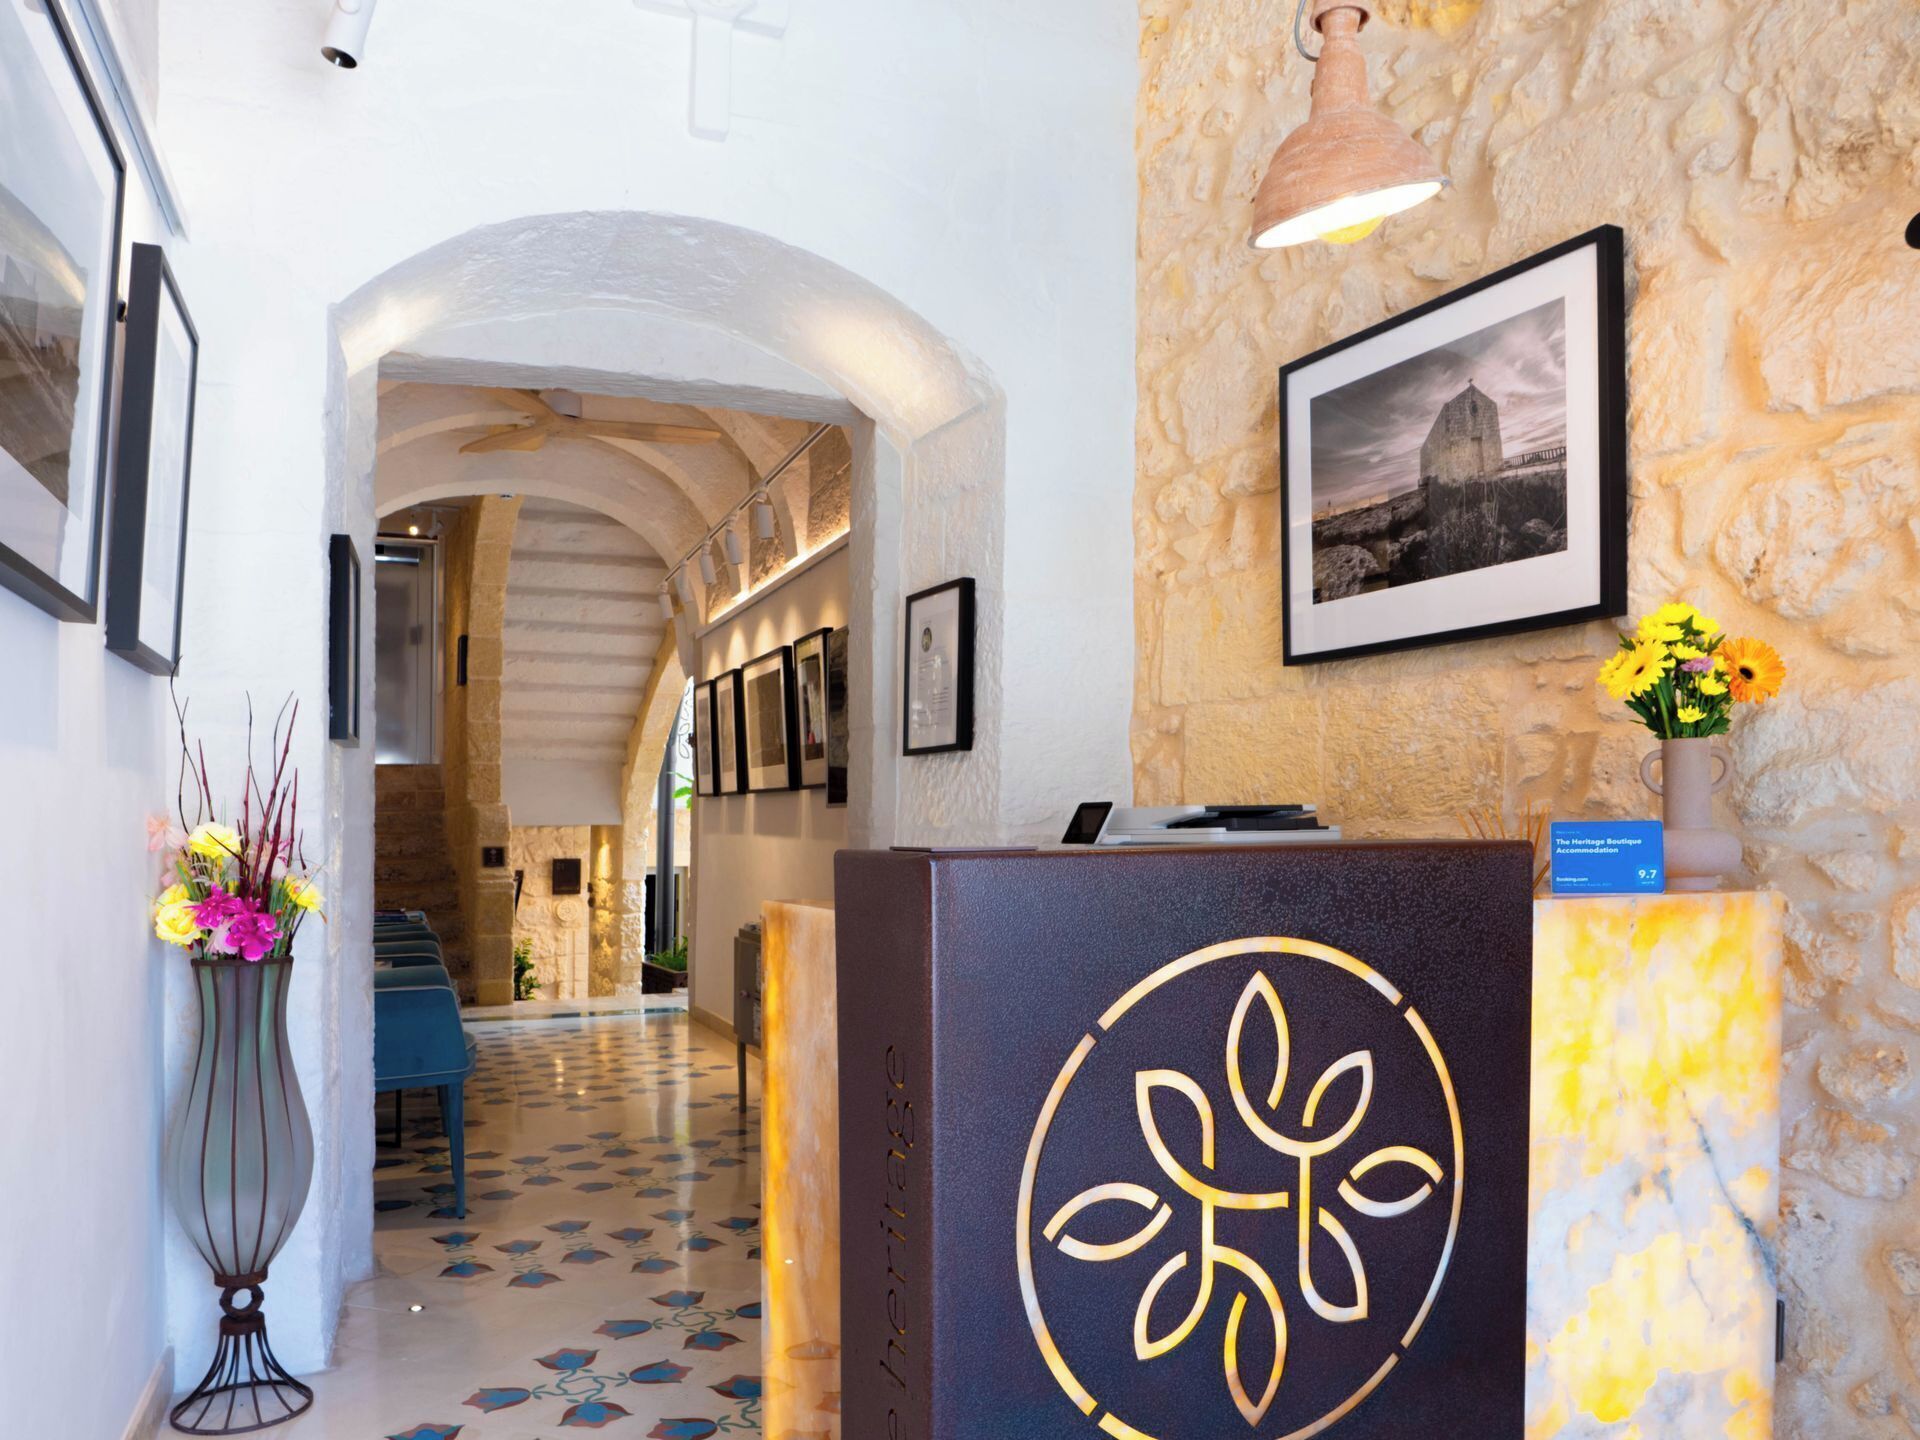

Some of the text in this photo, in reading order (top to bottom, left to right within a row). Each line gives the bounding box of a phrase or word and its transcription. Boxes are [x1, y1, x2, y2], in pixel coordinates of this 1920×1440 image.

[1572, 838, 1605, 847] Heritage
[1606, 838, 1642, 846] Boutique
[1638, 869, 1657, 879] 9.7
[879, 1044, 915, 1392] heritage
